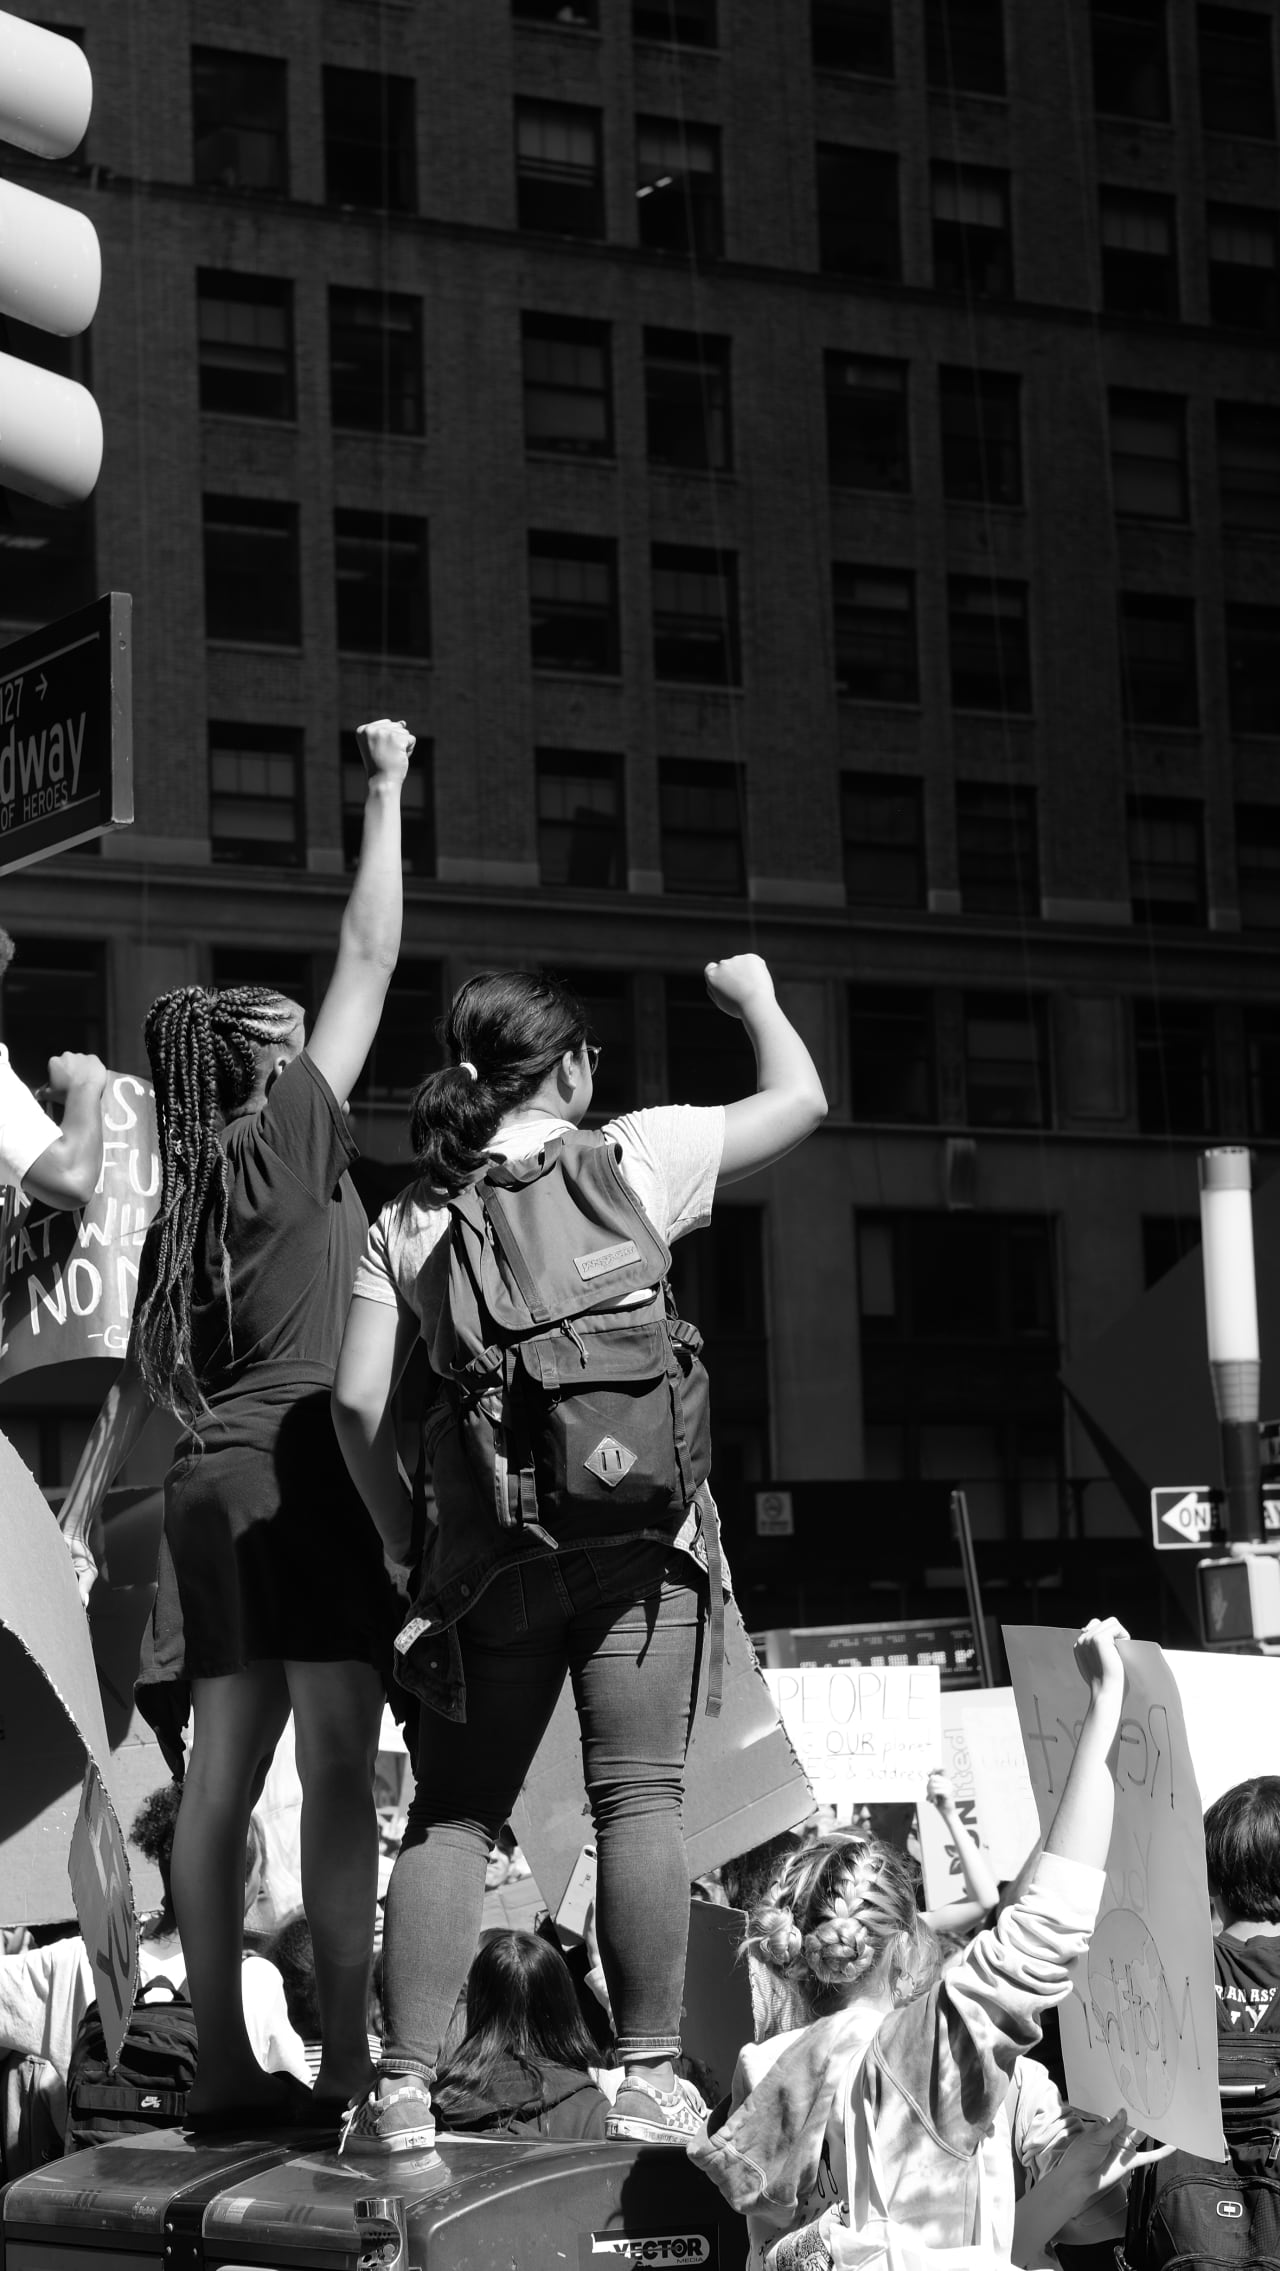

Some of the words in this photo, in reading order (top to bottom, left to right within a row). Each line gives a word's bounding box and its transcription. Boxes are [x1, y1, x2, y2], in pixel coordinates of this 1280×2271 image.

[1, 806, 15, 832] OF
[23, 780, 69, 823] HEROES
[778, 1672, 930, 1724] PEOPLE
[826, 1730, 875, 1754] OUR
[882, 1727, 934, 1763] planet
[613, 2237, 704, 2261] VECTOR
